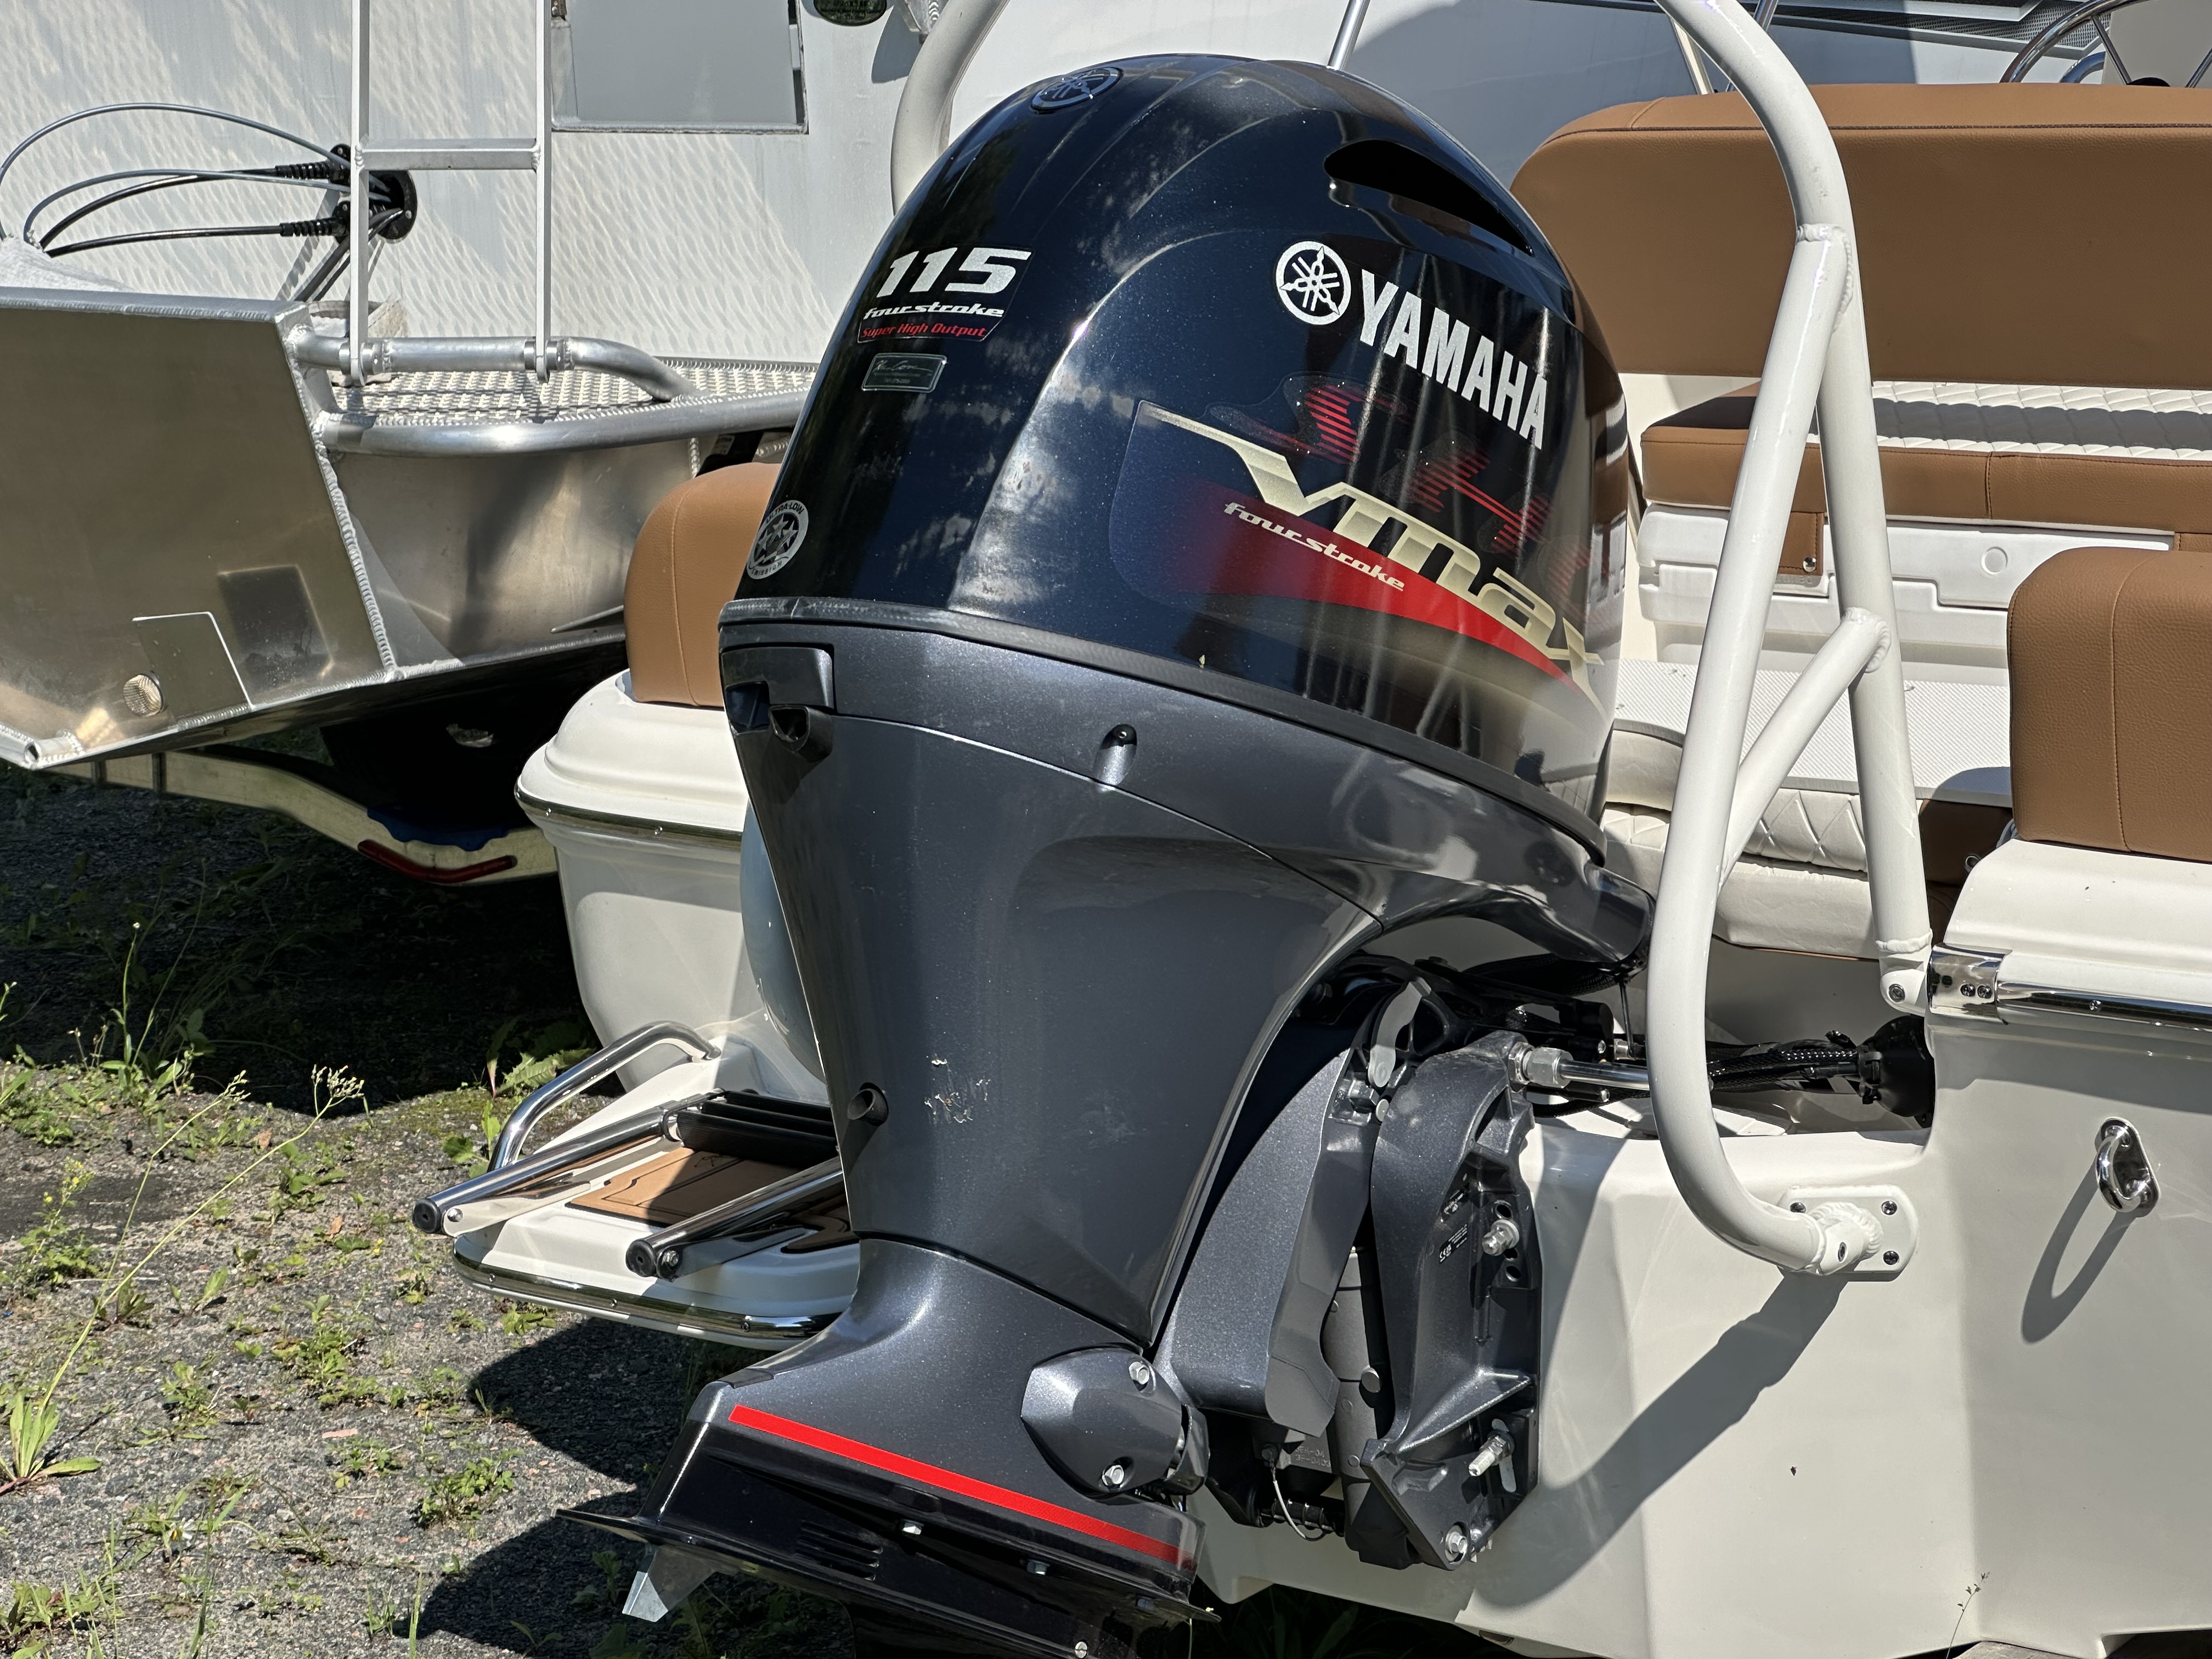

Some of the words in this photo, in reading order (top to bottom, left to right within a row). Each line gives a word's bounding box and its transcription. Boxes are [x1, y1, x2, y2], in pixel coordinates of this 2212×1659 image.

[877, 247, 1032, 298] 115
[862, 326, 896, 338] Super
[897, 323, 929, 335] High
[931, 323, 987, 336] Output
[1360, 269, 1548, 450] YAMAHA
[751, 560, 782, 575] EMISSION
